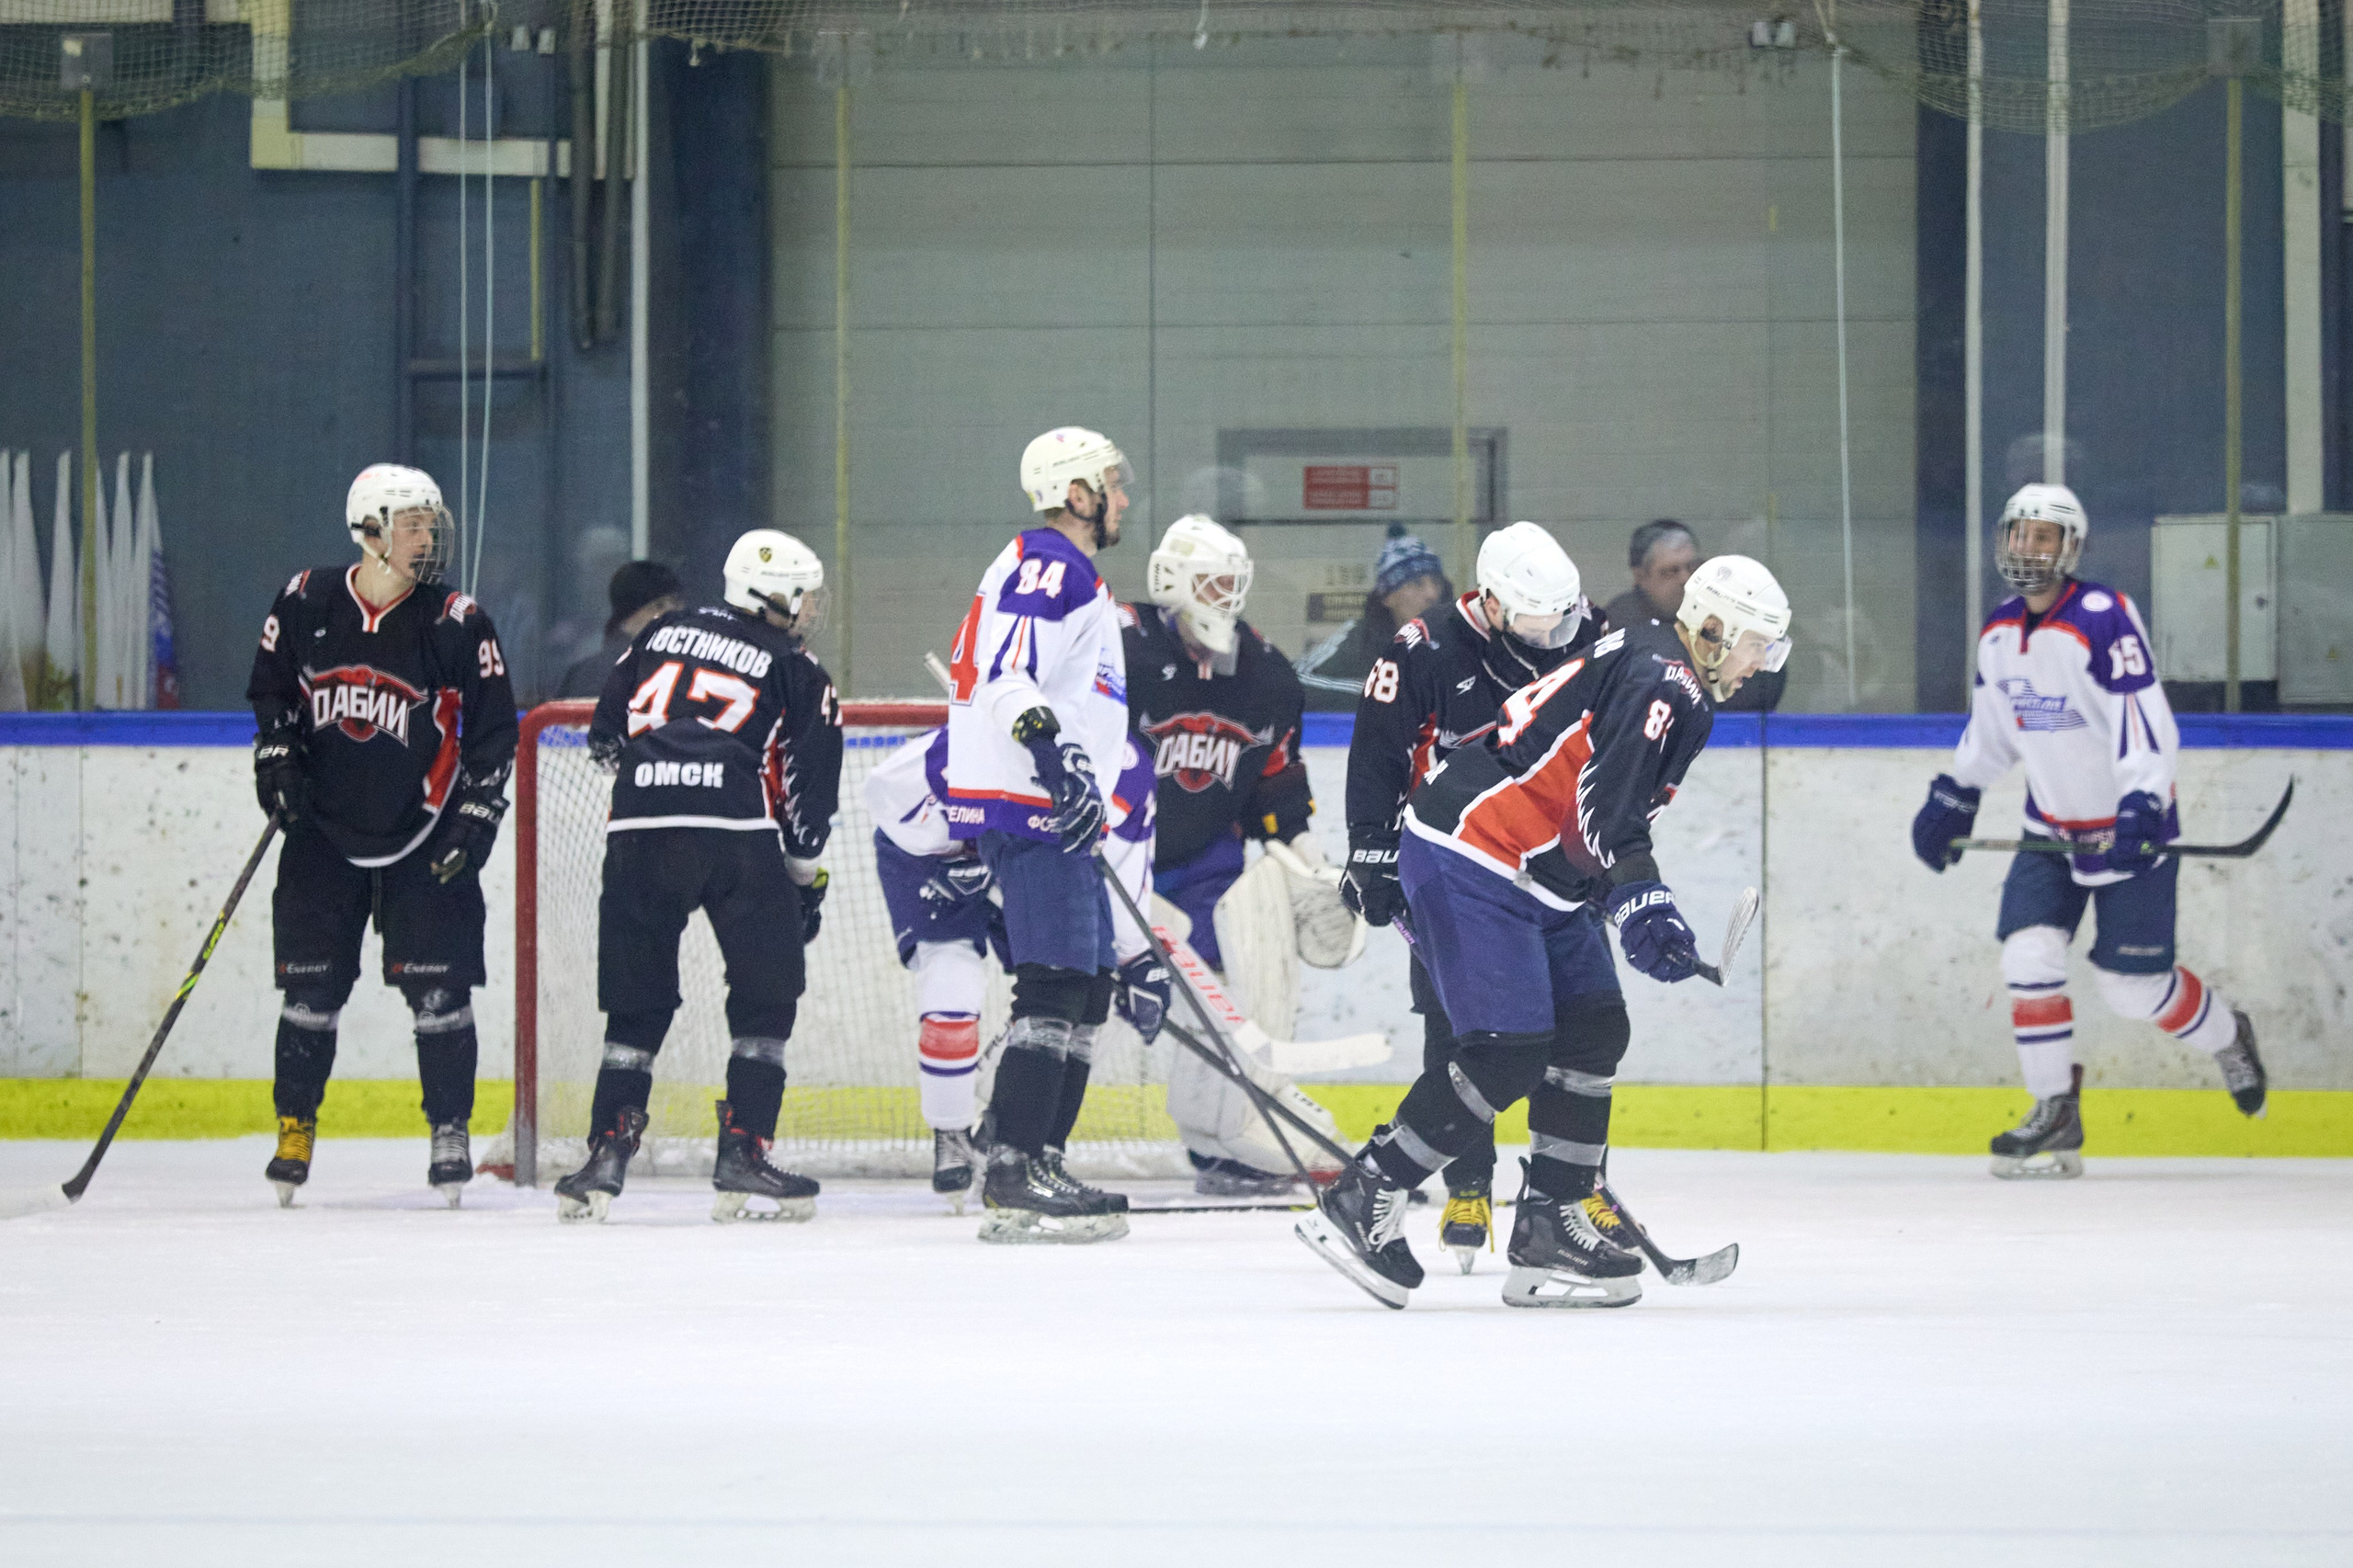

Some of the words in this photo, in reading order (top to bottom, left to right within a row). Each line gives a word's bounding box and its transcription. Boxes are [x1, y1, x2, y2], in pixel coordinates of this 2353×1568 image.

[1015, 558, 1066, 598] 84
[2108, 634, 2147, 680] 15
[627, 660, 761, 738] 47
[634, 761, 725, 789] ОМСК
[1614, 890, 1675, 930] BAUER
